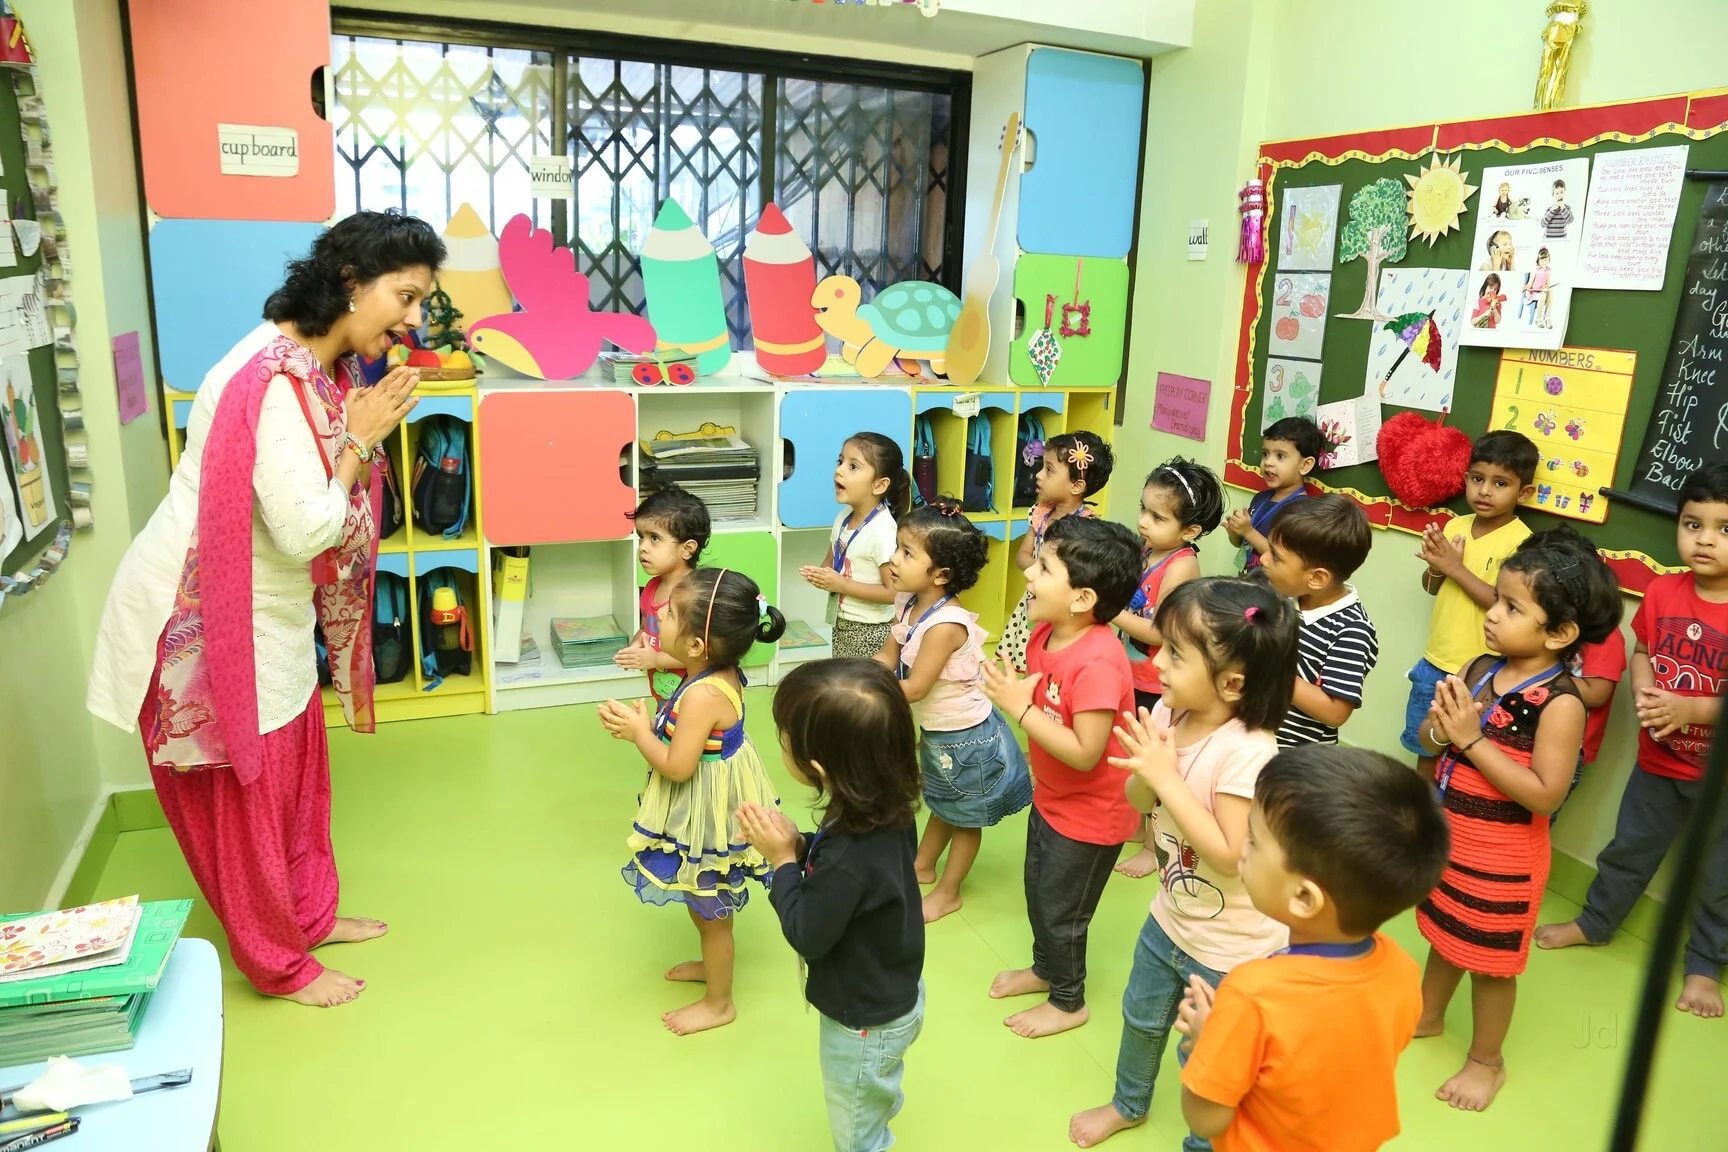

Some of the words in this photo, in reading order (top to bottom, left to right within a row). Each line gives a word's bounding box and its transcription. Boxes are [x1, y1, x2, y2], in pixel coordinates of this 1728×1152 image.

[1504, 169, 1520, 177] OUR
[1539, 164, 1564, 174] SENSES
[1188, 227, 1208, 245] wall
[1276, 278, 1293, 306] 2
[1690, 280, 1717, 312] day
[1528, 349, 1596, 369] NUMBERS
[1678, 334, 1722, 362] Arm
[1269, 364, 1284, 392] 3
[1678, 358, 1716, 386] Knee
[1666, 380, 1698, 422] Hip
[1504, 405, 1520, 430] 2
[1658, 409, 1692, 445] Fist
[1650, 439, 1702, 472] Elbow
[443, 612, 456, 622] D
